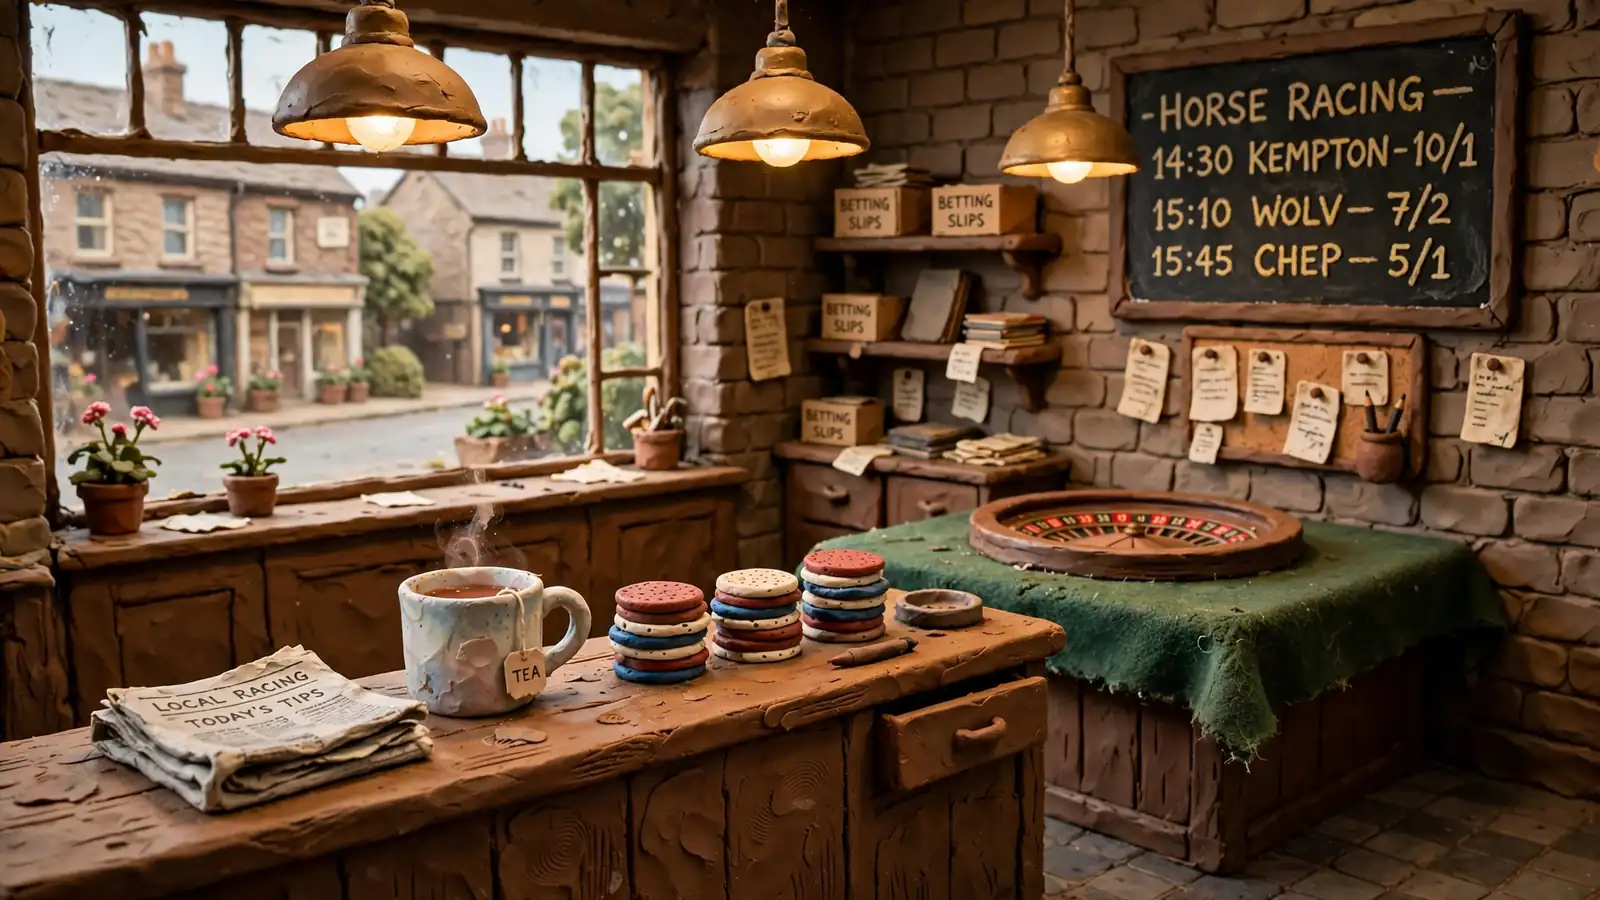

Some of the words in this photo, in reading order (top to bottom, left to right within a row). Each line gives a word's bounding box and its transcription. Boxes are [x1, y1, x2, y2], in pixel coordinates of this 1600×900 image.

[1152, 145, 1233, 180] 14:30
[840, 197, 890, 212] BETTING
[938, 194, 993, 210] BETTING
[1152, 197, 1232, 232] 15:10
[1387, 183, 1451, 232] 7/2
[849, 215, 882, 230] SLIPS
[948, 213, 985, 228] SLIPS
[1151, 244, 1233, 277] 15:45
[1388, 237, 1450, 287] 5/1
[826, 302, 872, 318] BETTING
[833, 319, 864, 334] SLIPS
[806, 409, 851, 425] BETTING
[813, 425, 843, 440] SLIPS
[511, 664, 541, 683] TEA
[152, 695, 227, 712] LOCAL
[232, 670, 309, 700] RACING
[184, 705, 273, 729] TODAY'S
[276, 688, 325, 708] TIPS
